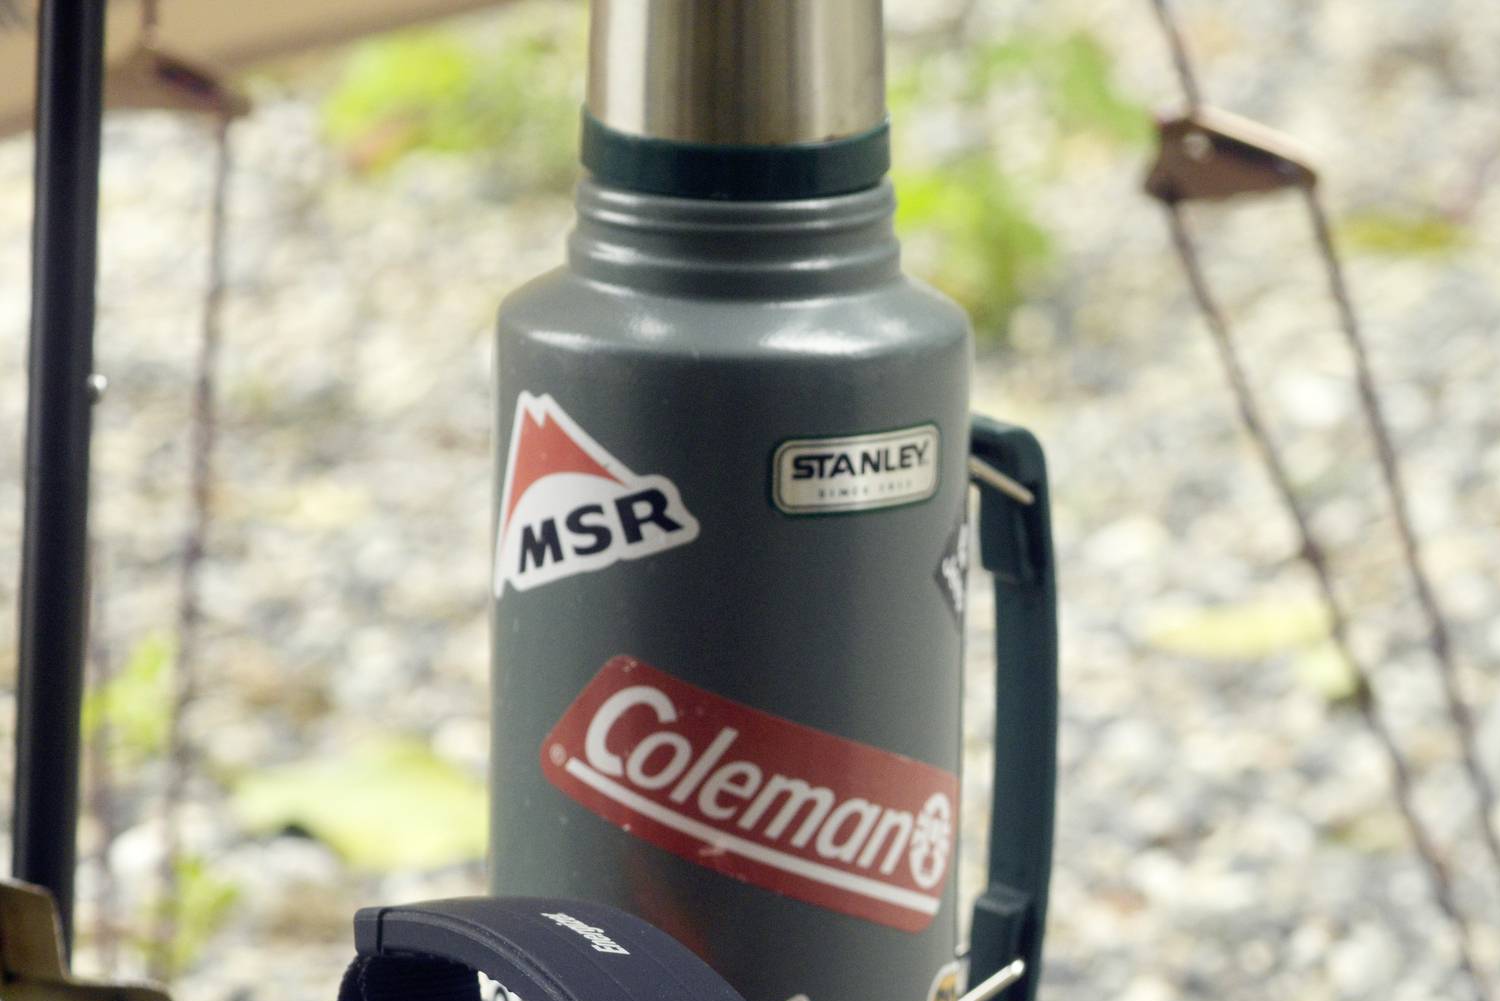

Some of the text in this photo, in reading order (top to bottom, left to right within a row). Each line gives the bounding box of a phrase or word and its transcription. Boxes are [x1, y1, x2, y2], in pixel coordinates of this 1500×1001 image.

[792, 440, 929, 480] STANLEY
[519, 486, 683, 574] MSR
[584, 685, 910, 876] Coleman
